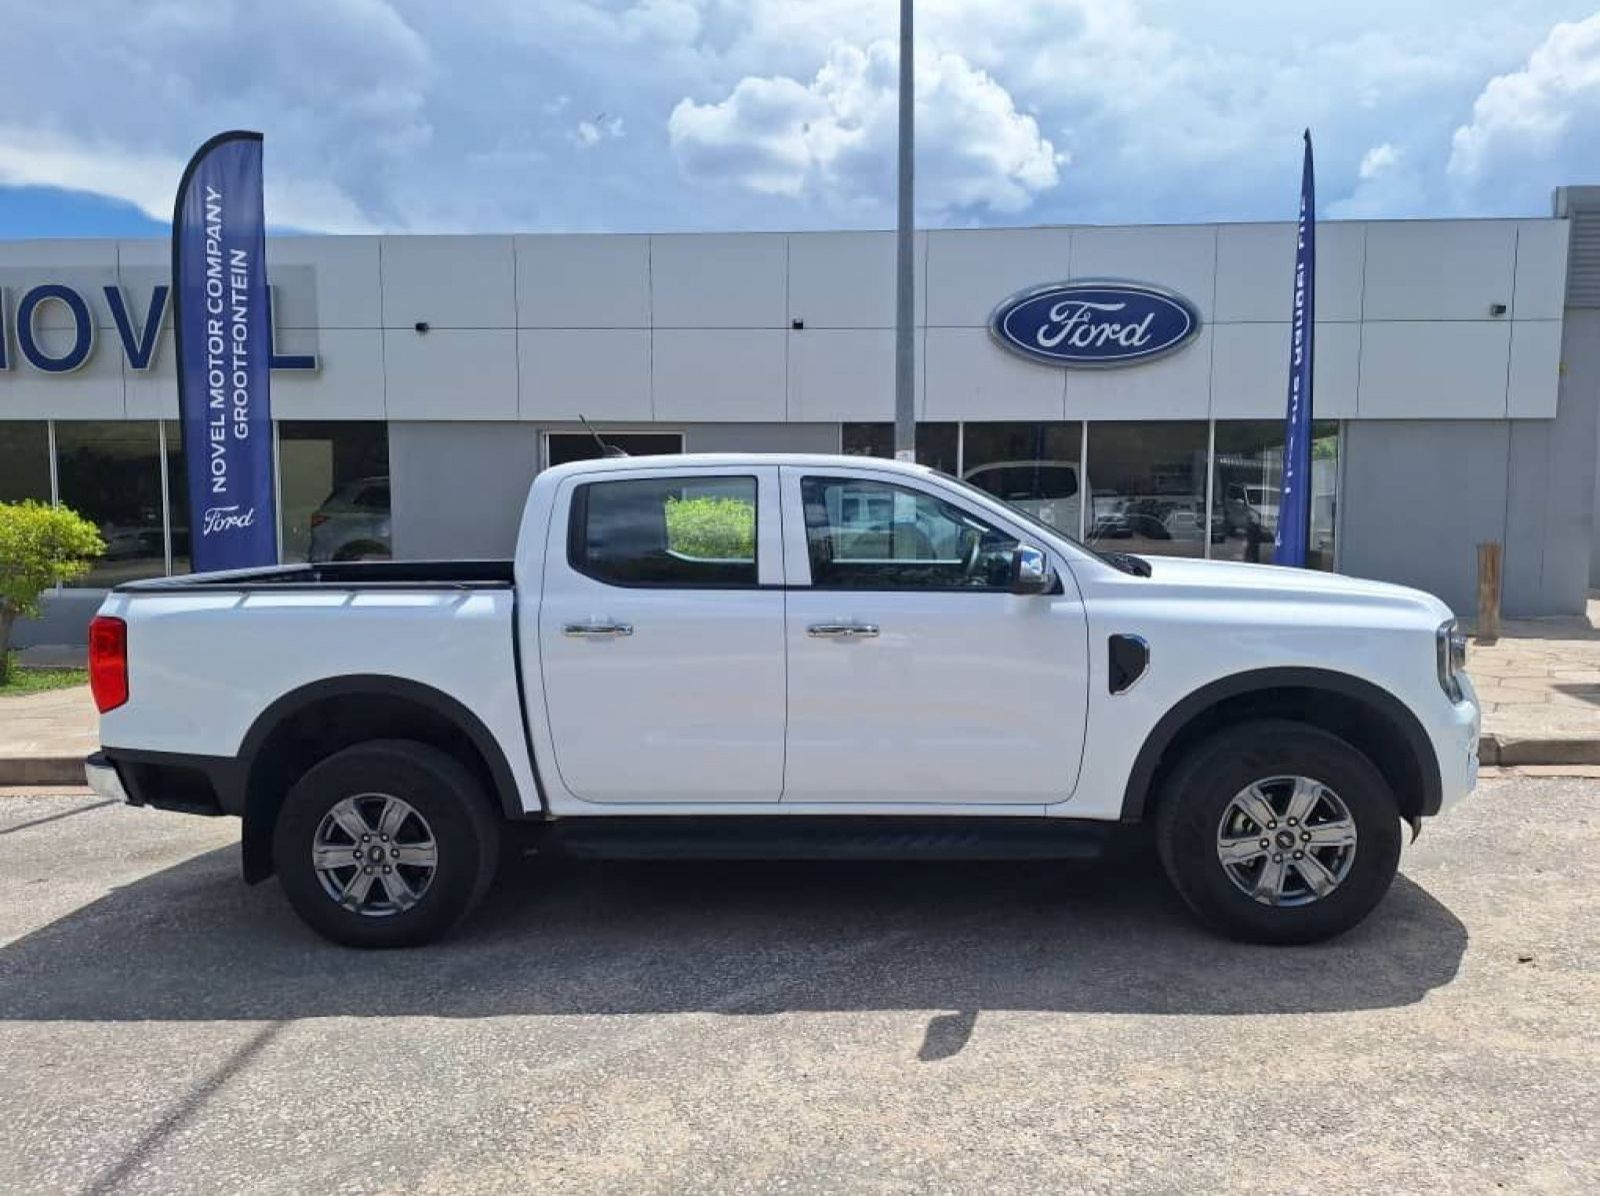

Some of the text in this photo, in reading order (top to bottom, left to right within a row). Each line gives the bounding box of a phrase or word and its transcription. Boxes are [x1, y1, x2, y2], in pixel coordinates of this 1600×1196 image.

[0, 284, 316, 371] OVL
[206, 185, 226, 493] NOVEL MOTOR COMPANY
[230, 249, 249, 439] GROOTFONTEIN
[1037, 300, 1155, 346] Ford
[203, 505, 254, 536] Ford
